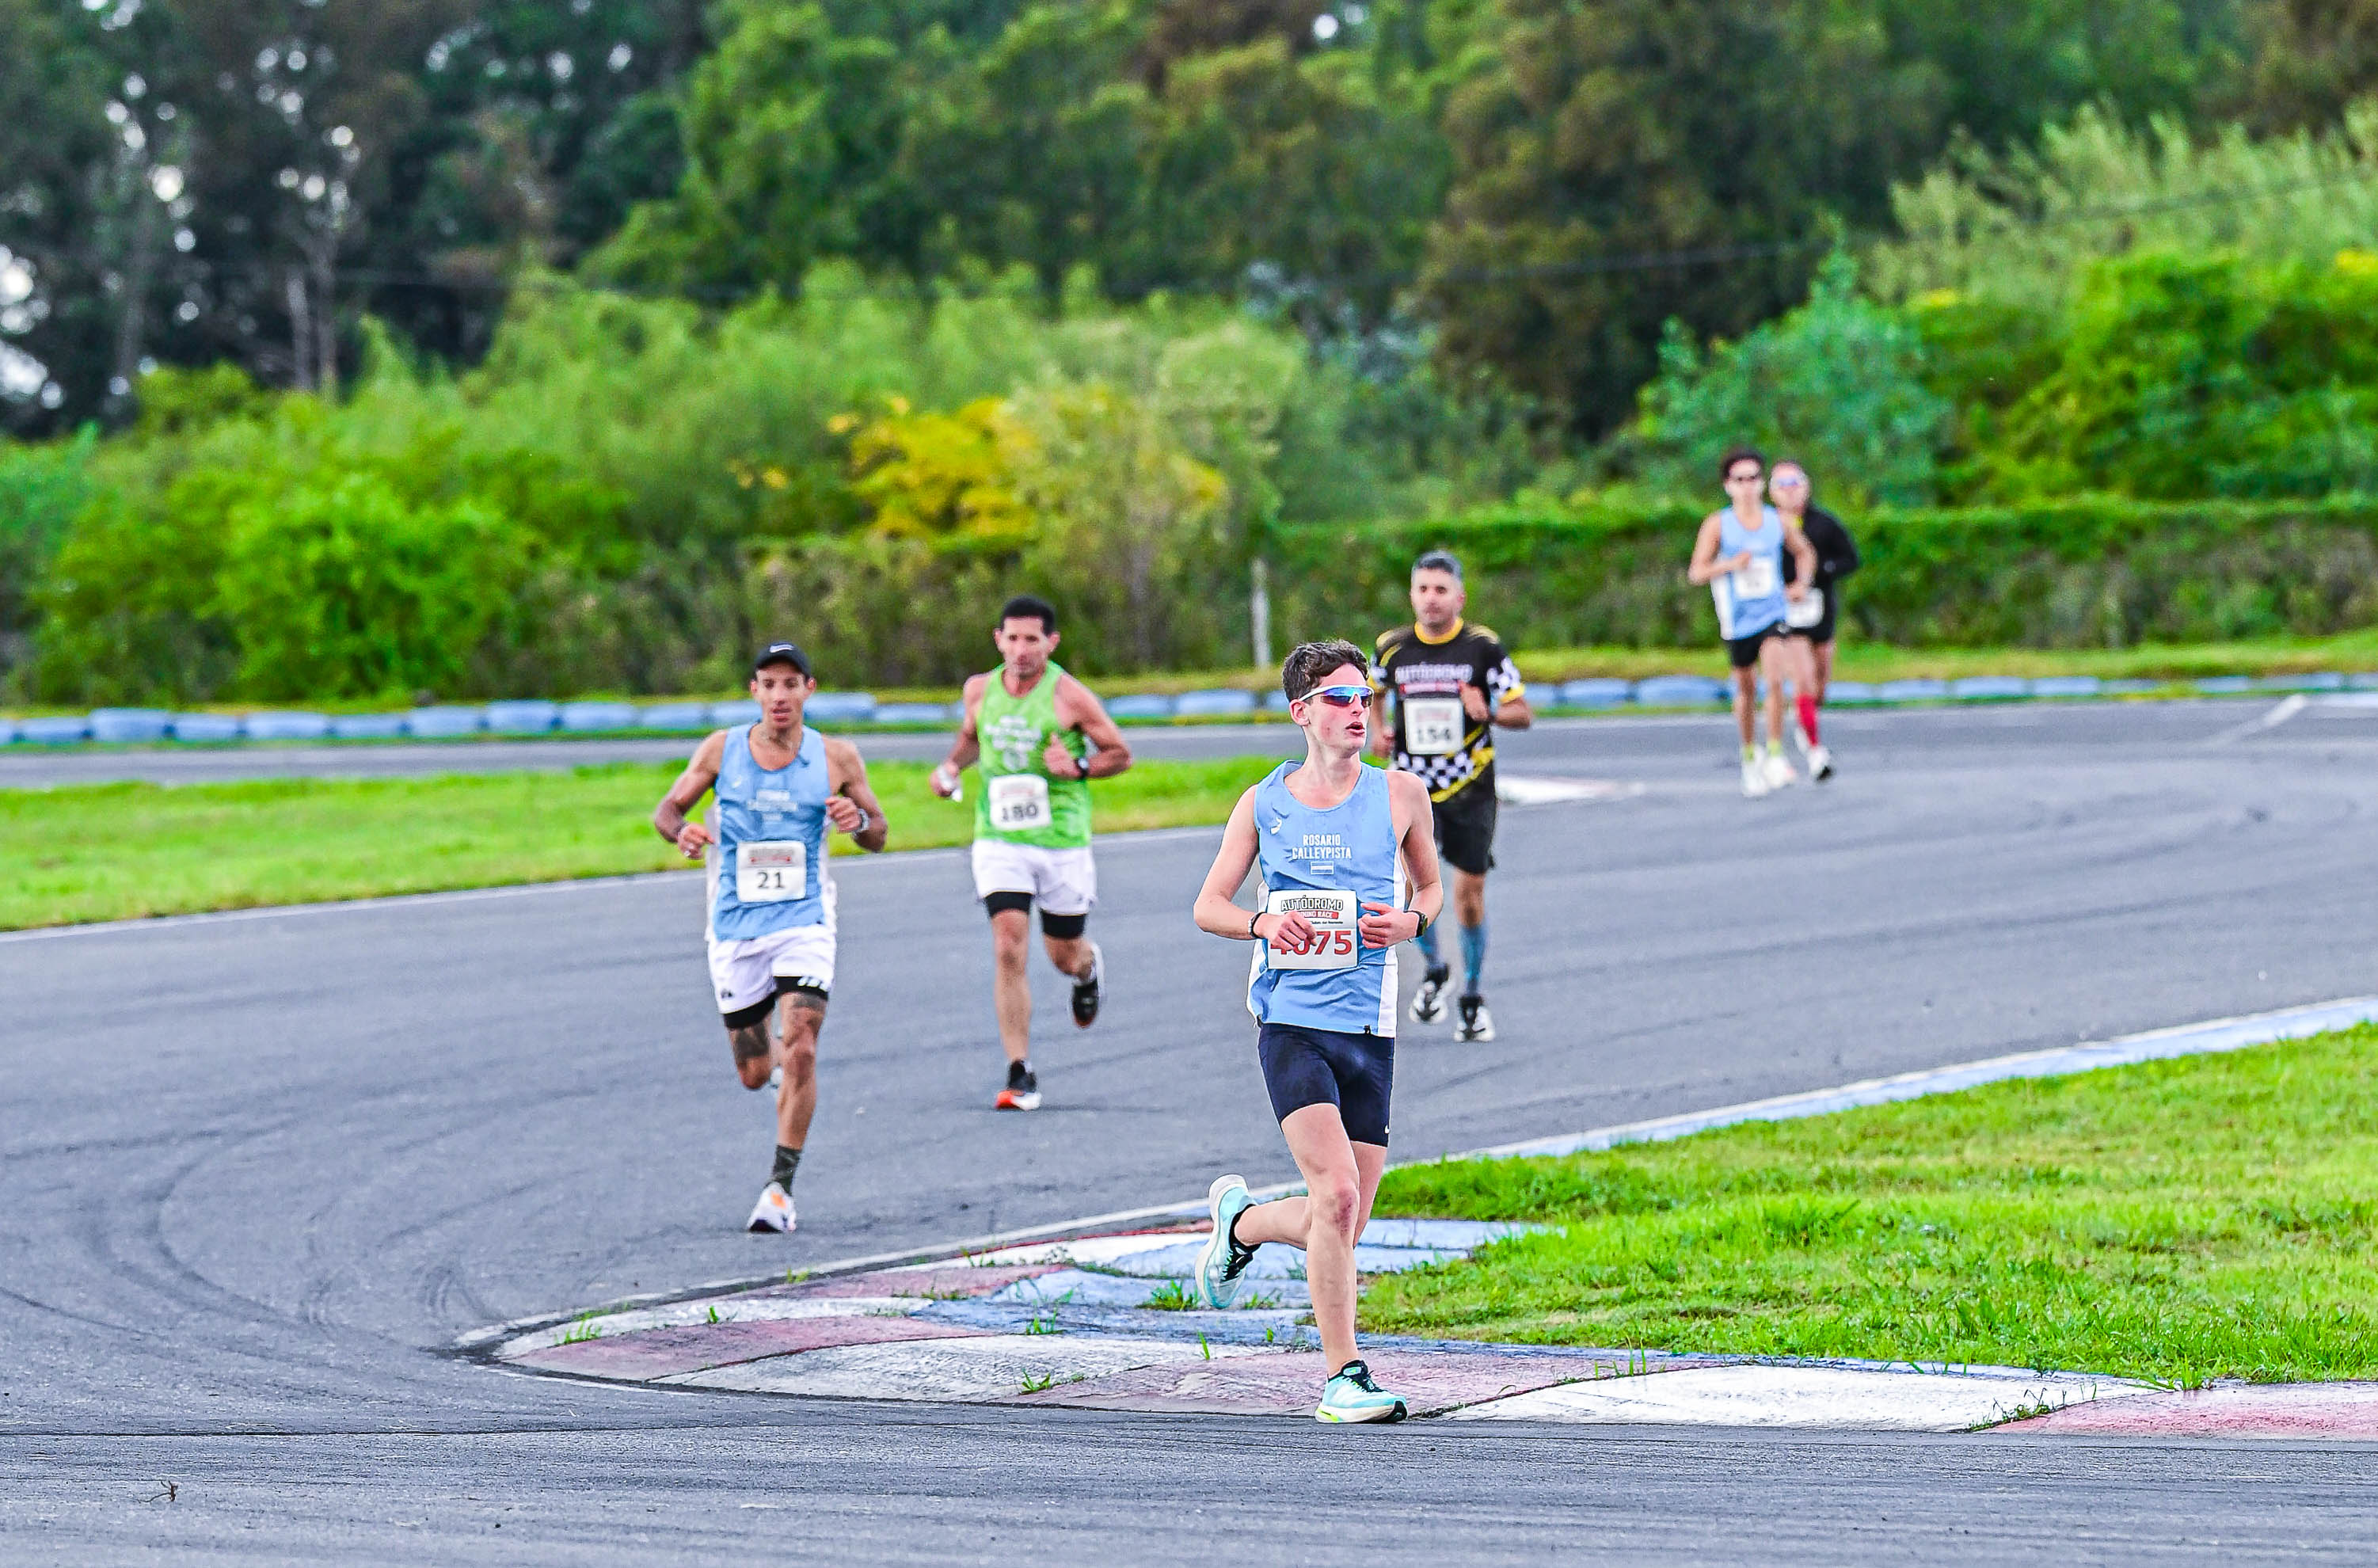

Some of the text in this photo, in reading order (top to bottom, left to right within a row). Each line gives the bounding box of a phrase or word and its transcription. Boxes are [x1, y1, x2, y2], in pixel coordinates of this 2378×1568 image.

[1303, 834, 1341, 846] ROSARIO
[1292, 847, 1352, 860] CALLEYPISTA
[756, 871, 785, 889] 21
[1280, 894, 1344, 911] AUTÓDROMO
